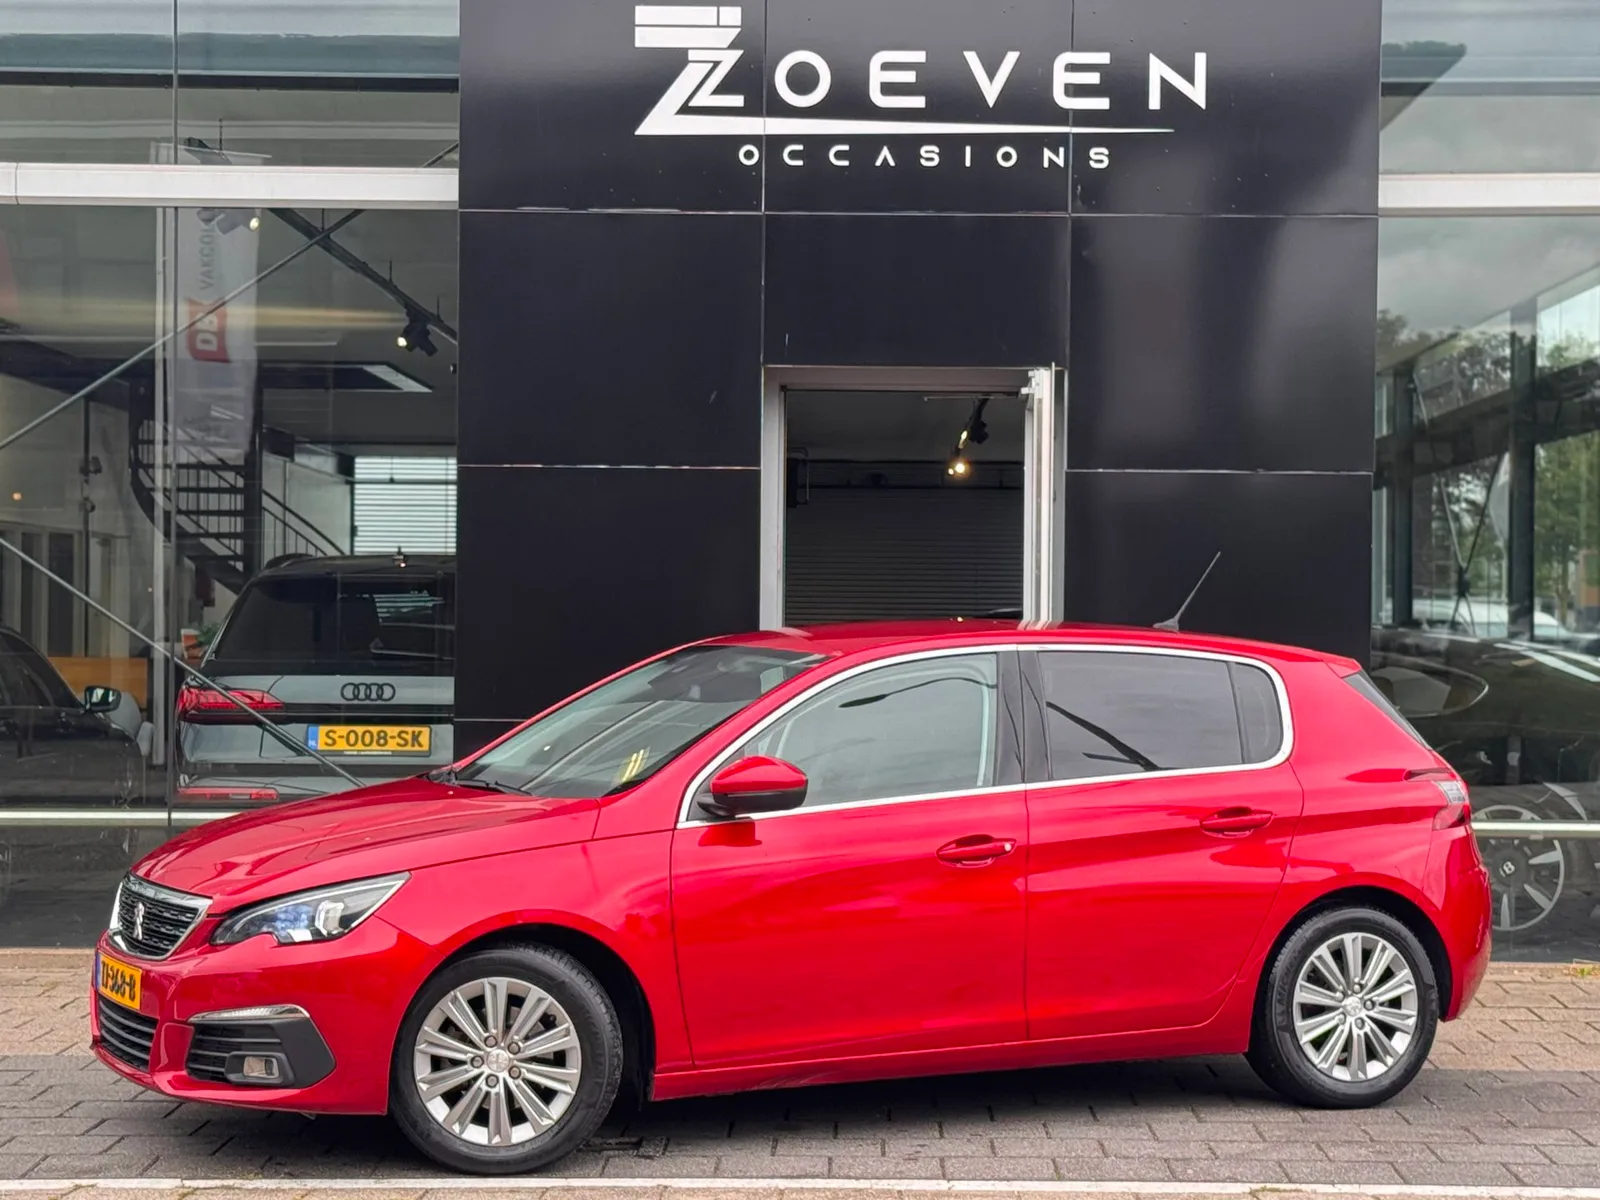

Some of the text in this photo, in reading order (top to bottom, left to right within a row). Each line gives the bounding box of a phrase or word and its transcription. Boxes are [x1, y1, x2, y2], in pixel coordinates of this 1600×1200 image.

[635, 6, 1207, 135] ZOEVEN
[738, 144, 1110, 168] OCCASIONS
[324, 730, 424, 748] S-008-SK
